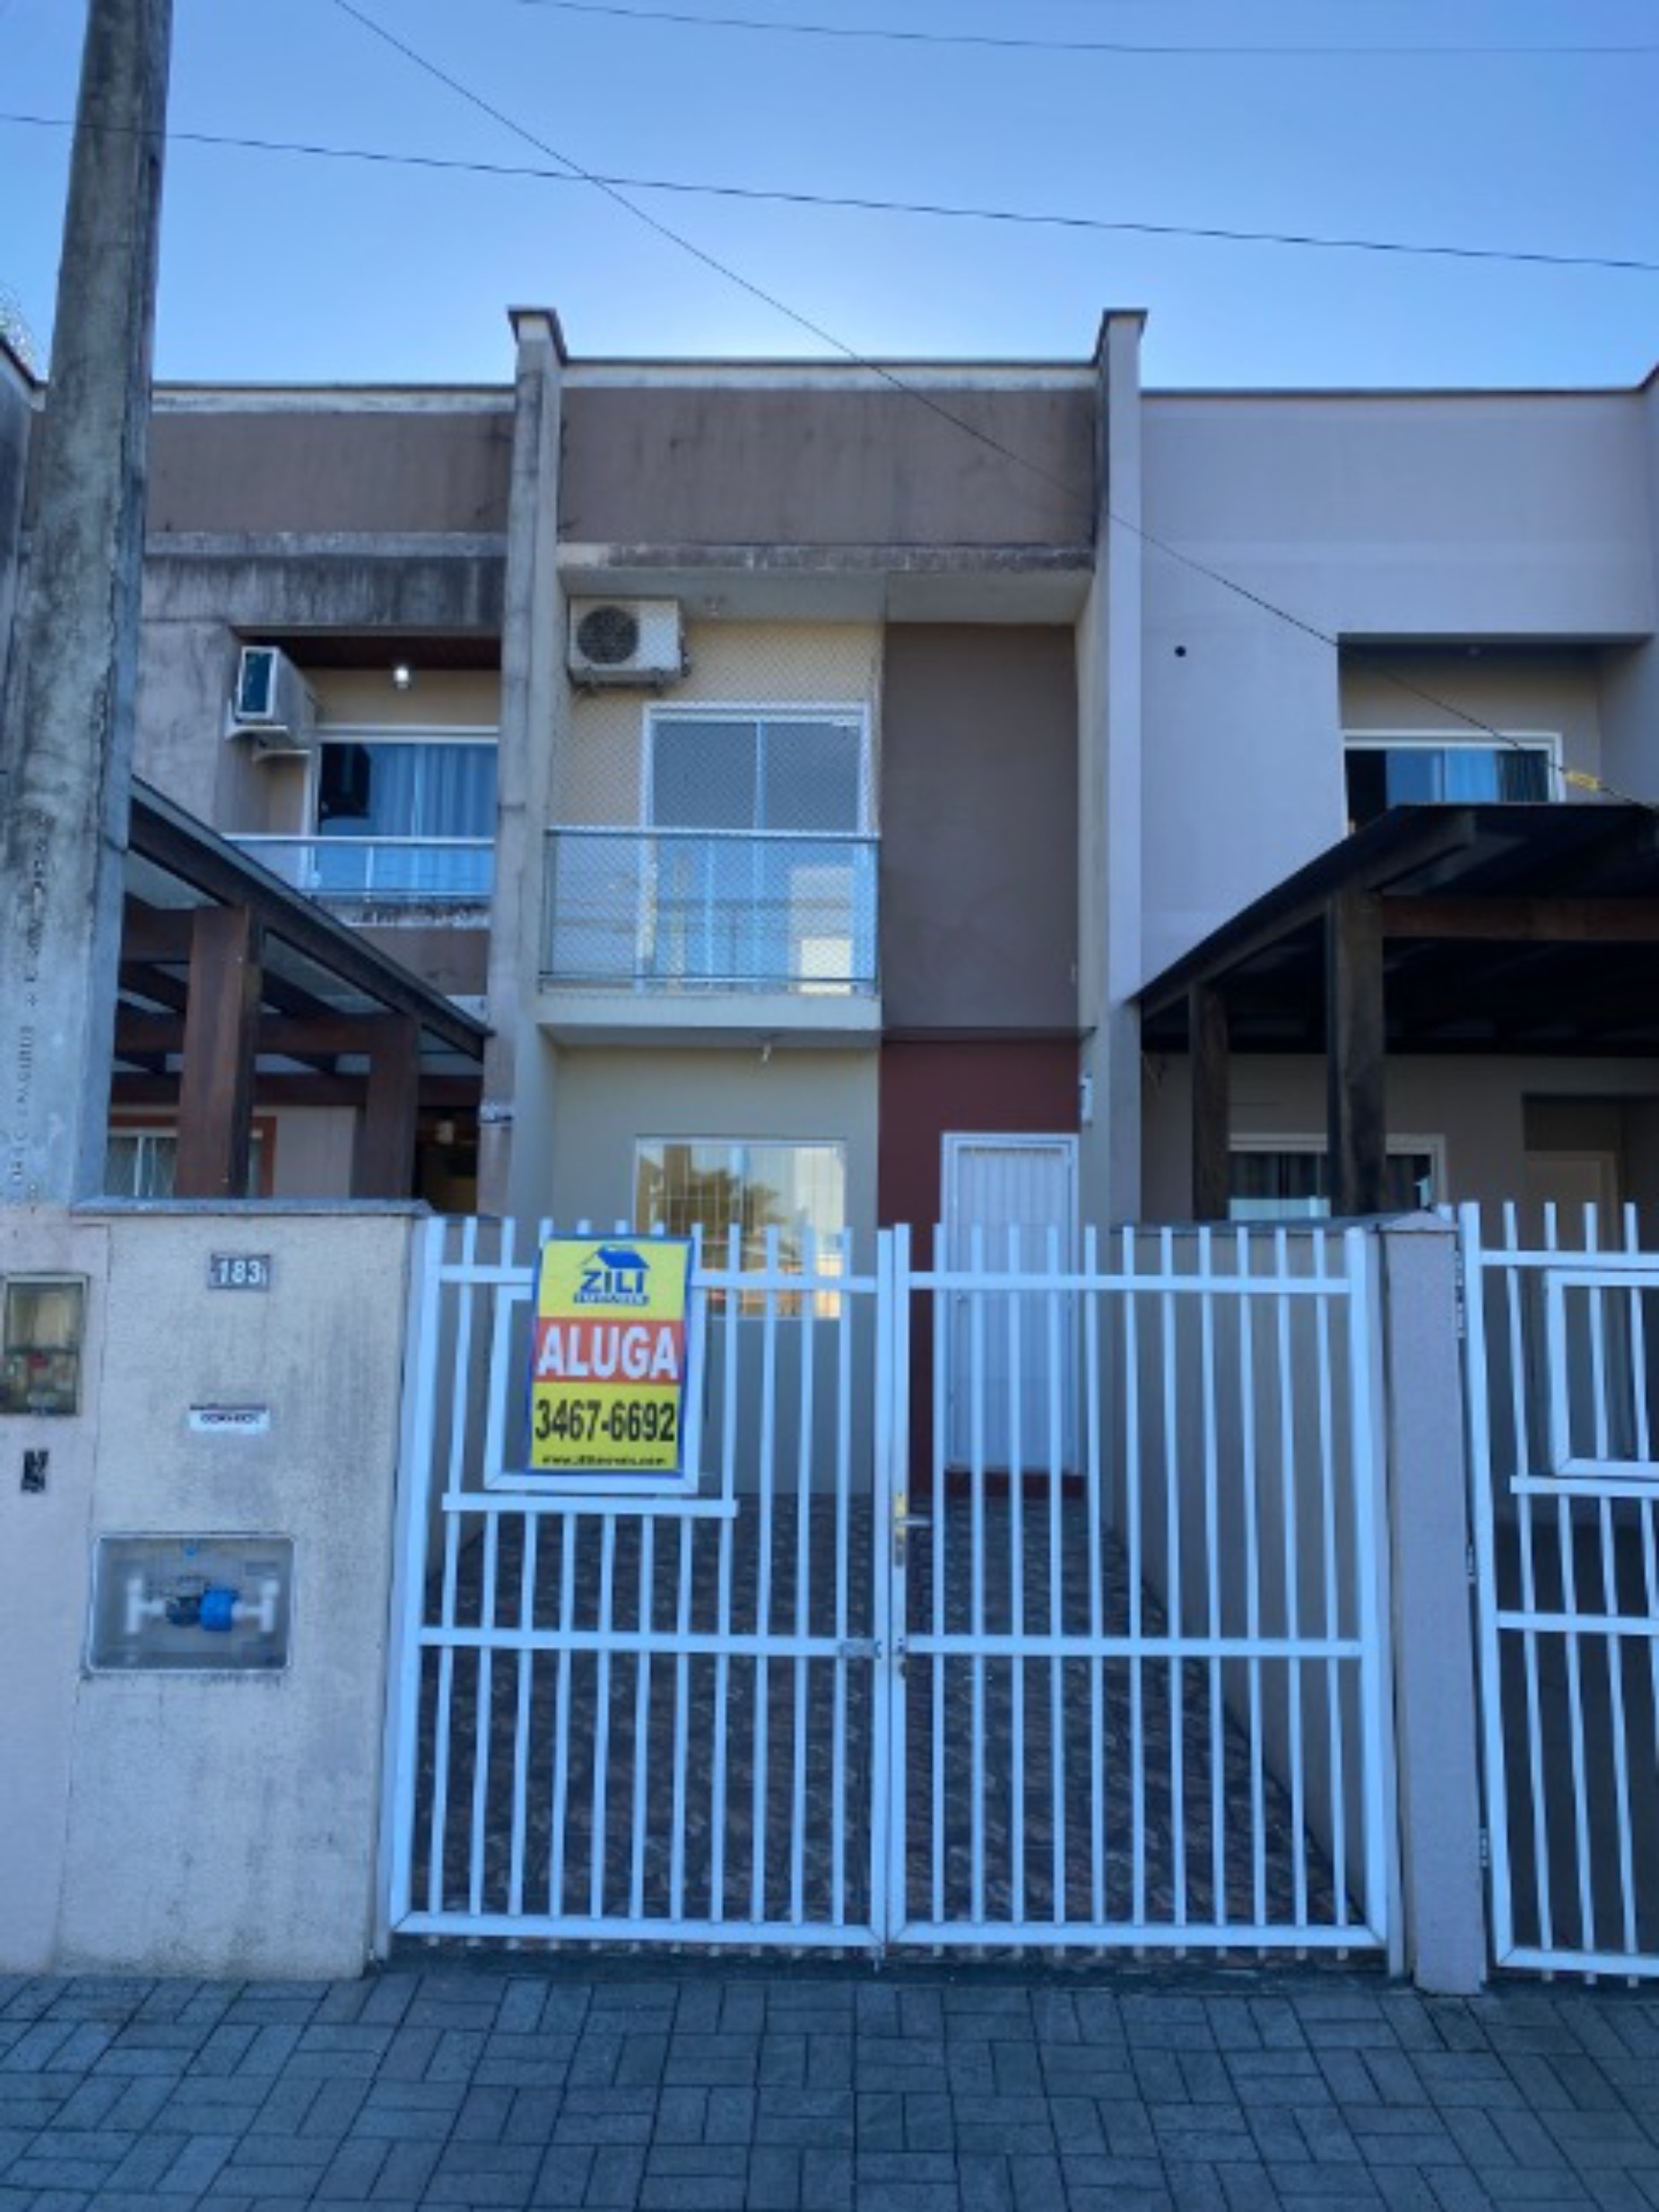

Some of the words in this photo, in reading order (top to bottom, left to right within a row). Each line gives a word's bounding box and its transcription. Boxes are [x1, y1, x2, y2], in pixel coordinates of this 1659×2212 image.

[220, 1260, 260, 1283] 183
[580, 1271, 644, 1293] ZILI
[537, 1324, 678, 1379] ALUGA
[535, 1399, 674, 1443] 3467-6692
